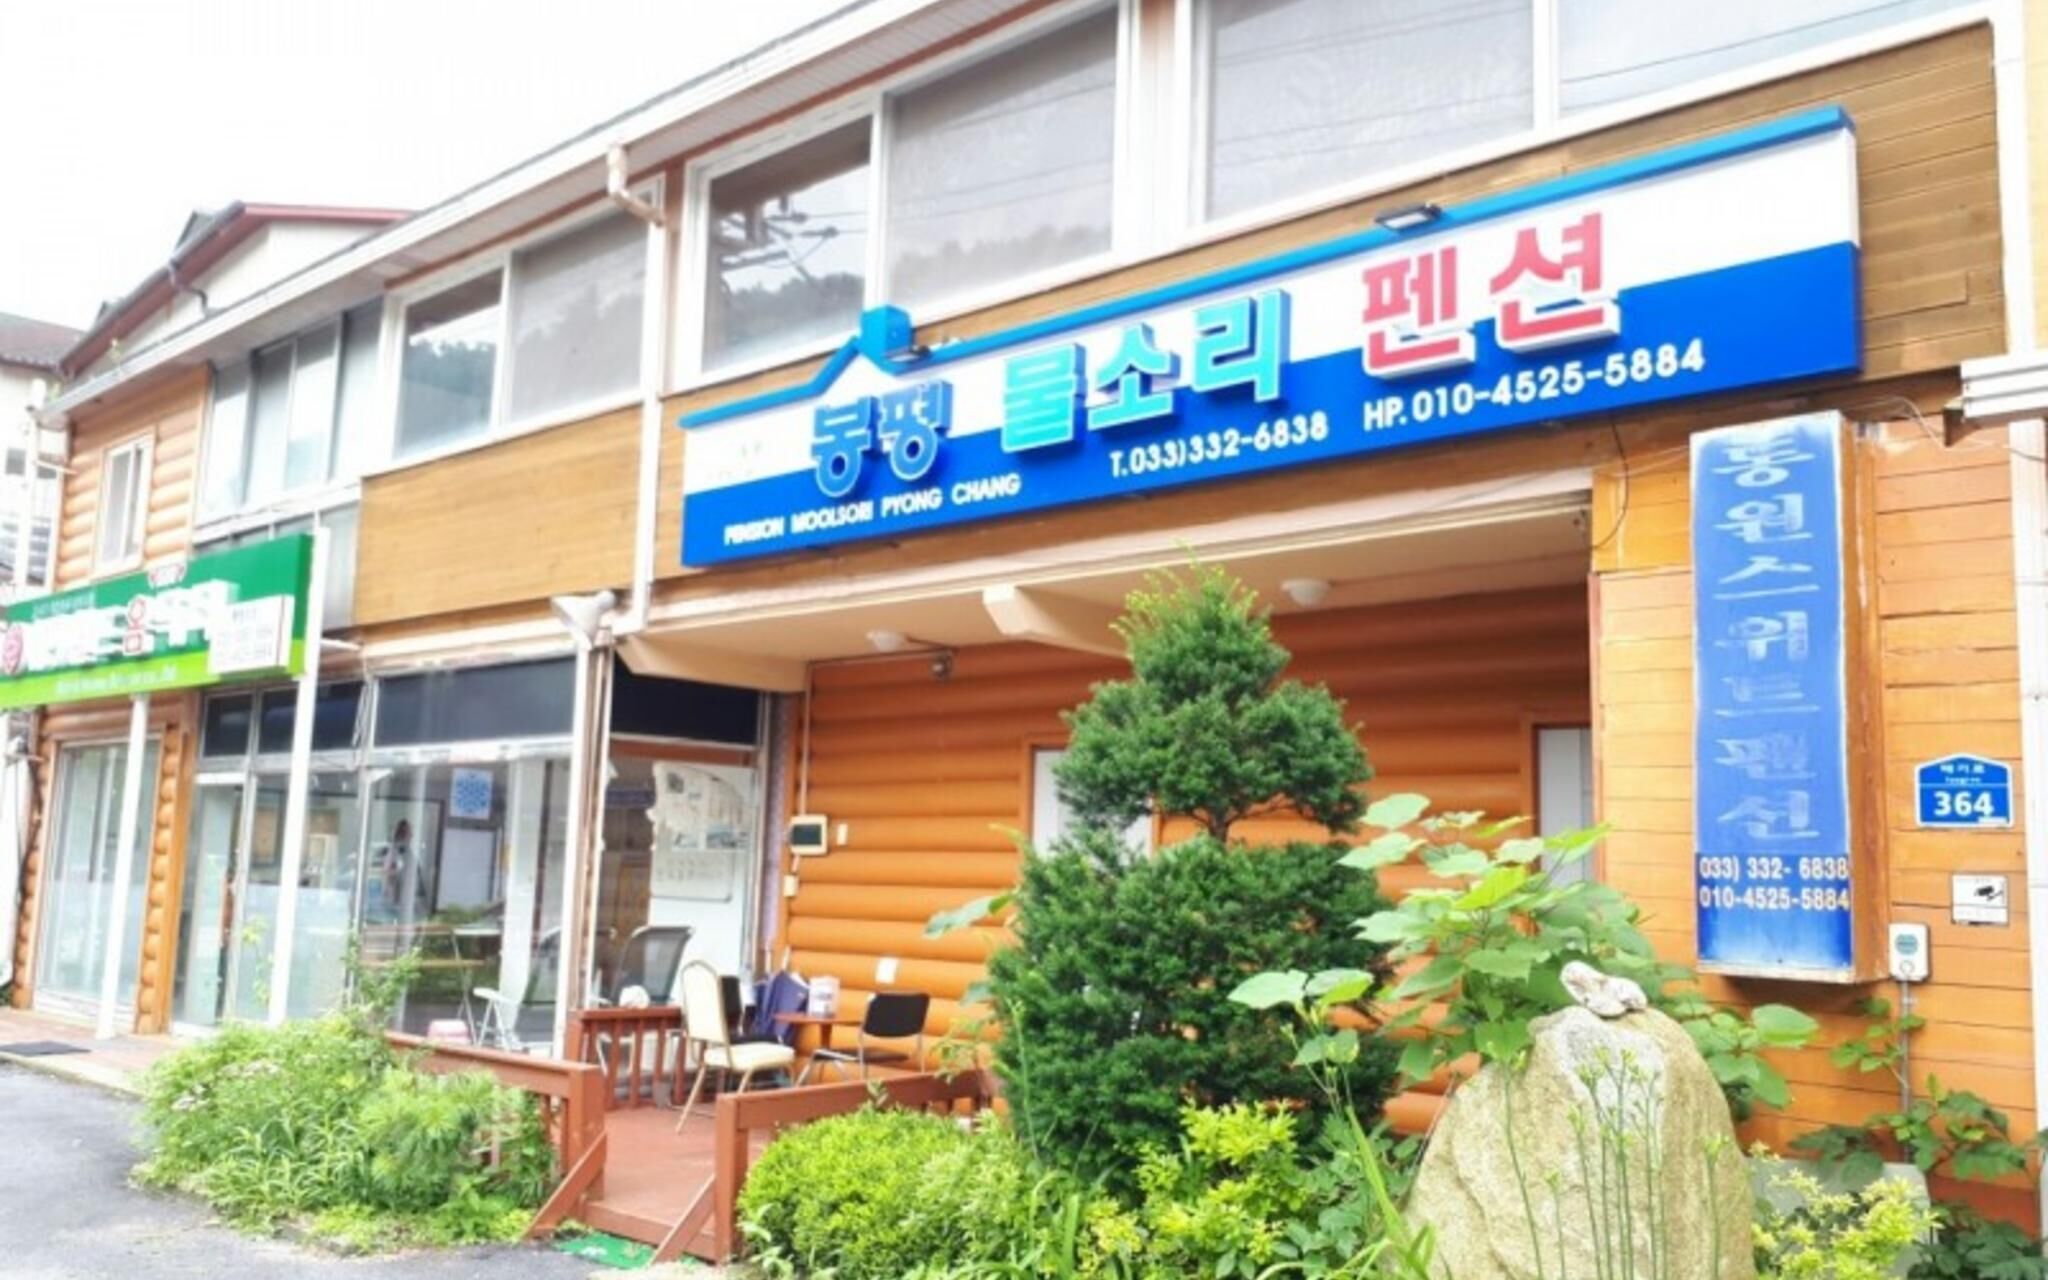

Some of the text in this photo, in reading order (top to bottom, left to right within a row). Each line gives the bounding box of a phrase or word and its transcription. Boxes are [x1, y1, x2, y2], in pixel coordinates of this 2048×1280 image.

[811, 211, 1620, 500] 봉평 물소리 펜션
[1362, 337, 1706, 432] HP.010-4525-5884
[1109, 410, 1330, 479] T.033)332-6838
[790, 500, 876, 535] MOOLSORI
[880, 487, 944, 518] PYONG
[950, 472, 1022, 506] CHANG
[1933, 790, 1996, 818] 364
[1699, 854, 1849, 883] 033) 332- 6838
[1699, 884, 1849, 911] 010-4525-5884
